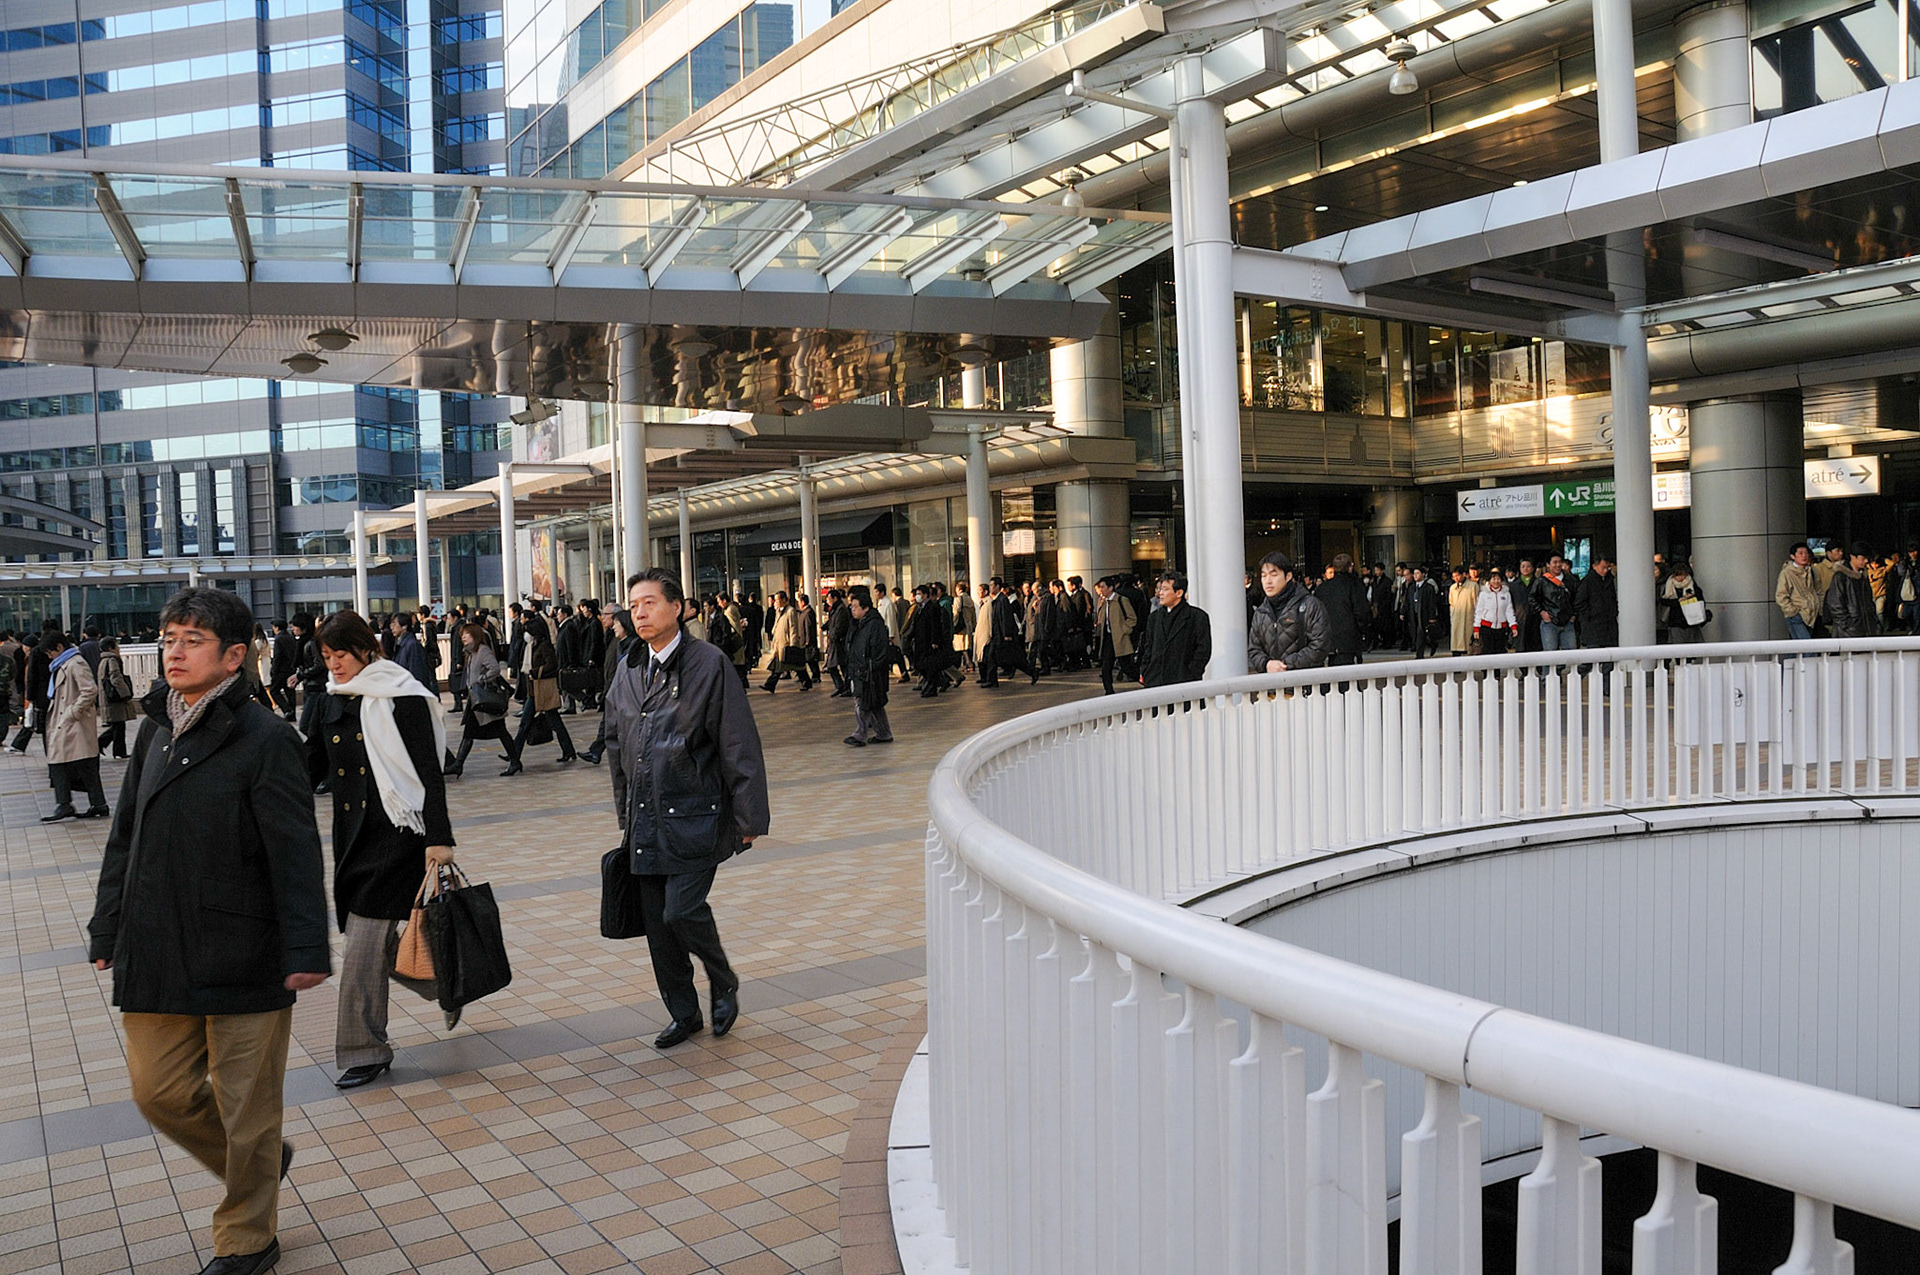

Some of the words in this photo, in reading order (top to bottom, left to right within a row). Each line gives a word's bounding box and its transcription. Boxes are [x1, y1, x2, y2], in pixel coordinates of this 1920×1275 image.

[1811, 467, 1845, 484] atré
[1505, 492, 1538, 502] アトレ品川
[1568, 486, 1591, 502] JR
[1478, 495, 1502, 510] atré
[771, 542, 787, 551] DEAN
[788, 541, 793, 549] &
